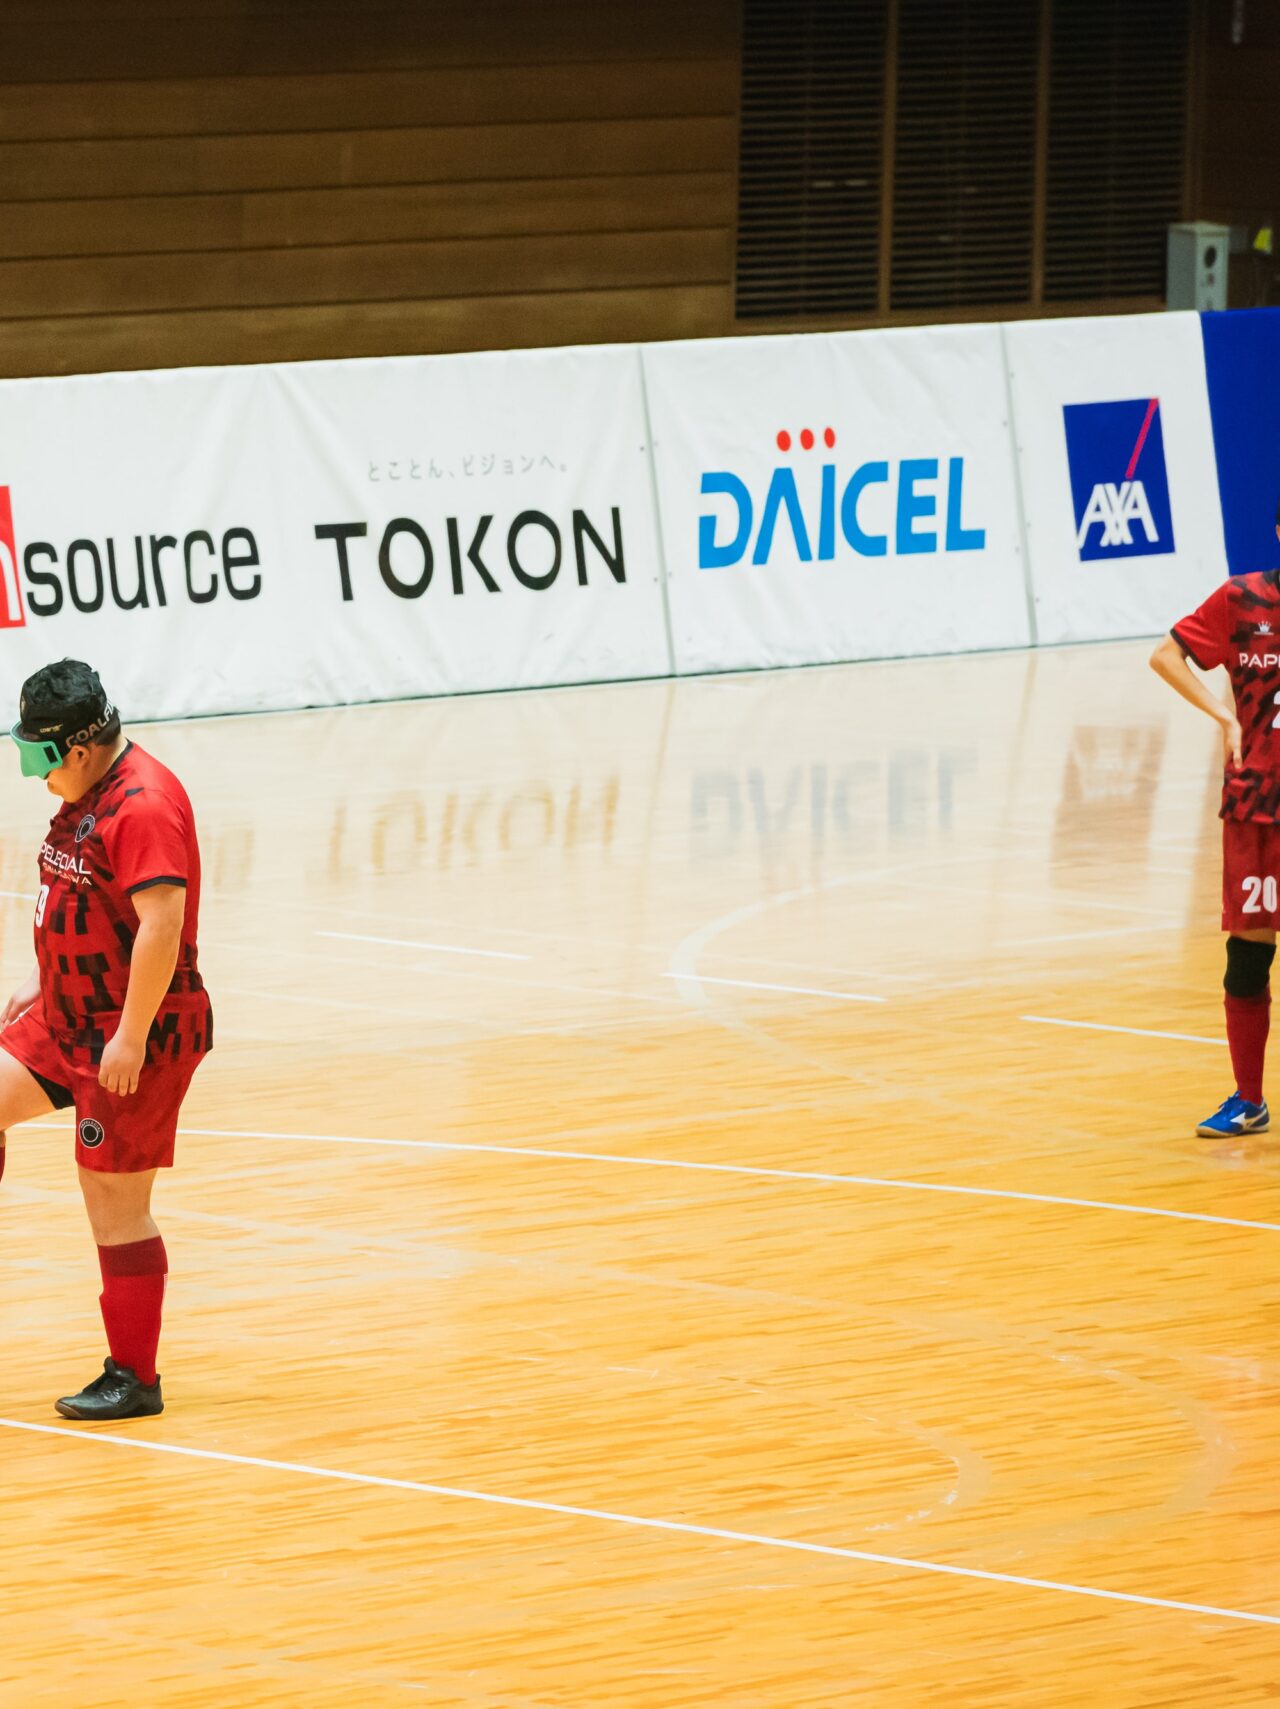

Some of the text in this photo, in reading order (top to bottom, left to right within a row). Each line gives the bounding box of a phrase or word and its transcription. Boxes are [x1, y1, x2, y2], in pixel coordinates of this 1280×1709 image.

[698, 456, 986, 569] DAICEL
[1077, 481, 1160, 550] AXA
[314, 506, 627, 602] TOKON
[1239, 652, 1280, 668] PAP
[1241, 875, 1278, 914] 20
